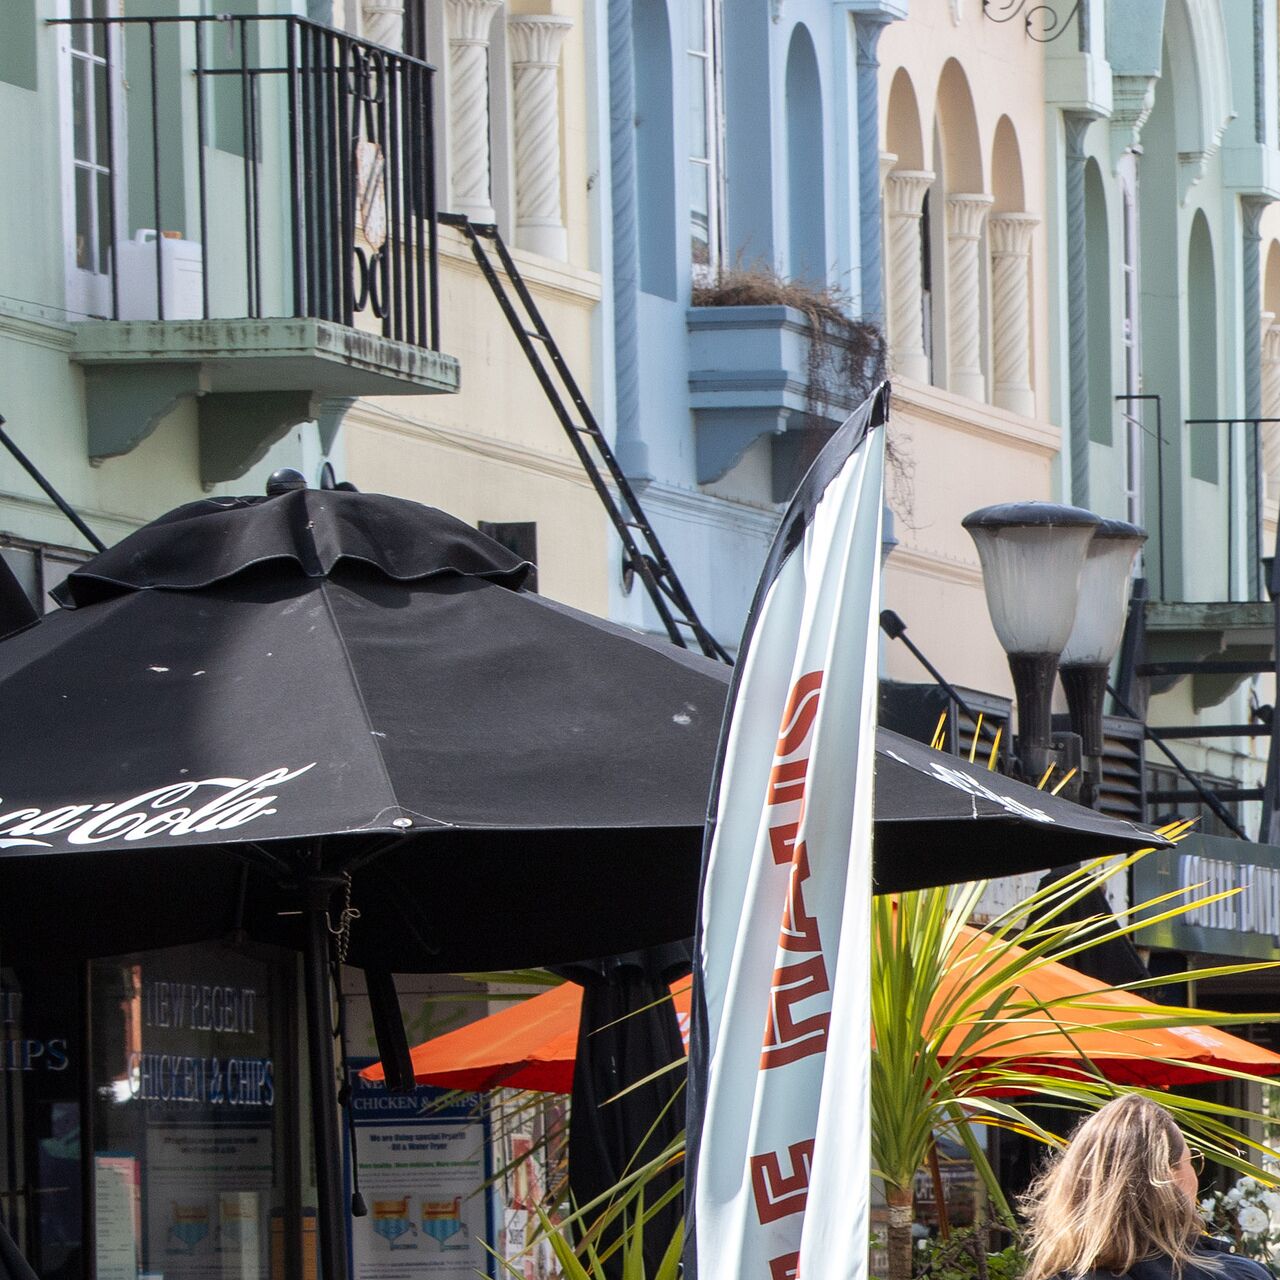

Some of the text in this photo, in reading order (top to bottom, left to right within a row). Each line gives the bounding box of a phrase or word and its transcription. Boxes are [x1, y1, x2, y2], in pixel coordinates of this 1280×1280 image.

[0, 763, 316, 848] ca-Cola
[0, 1039, 69, 1071] IPS
[227, 1058, 274, 1106] CHIPS
[354, 1097, 417, 1110] CHICKEN
